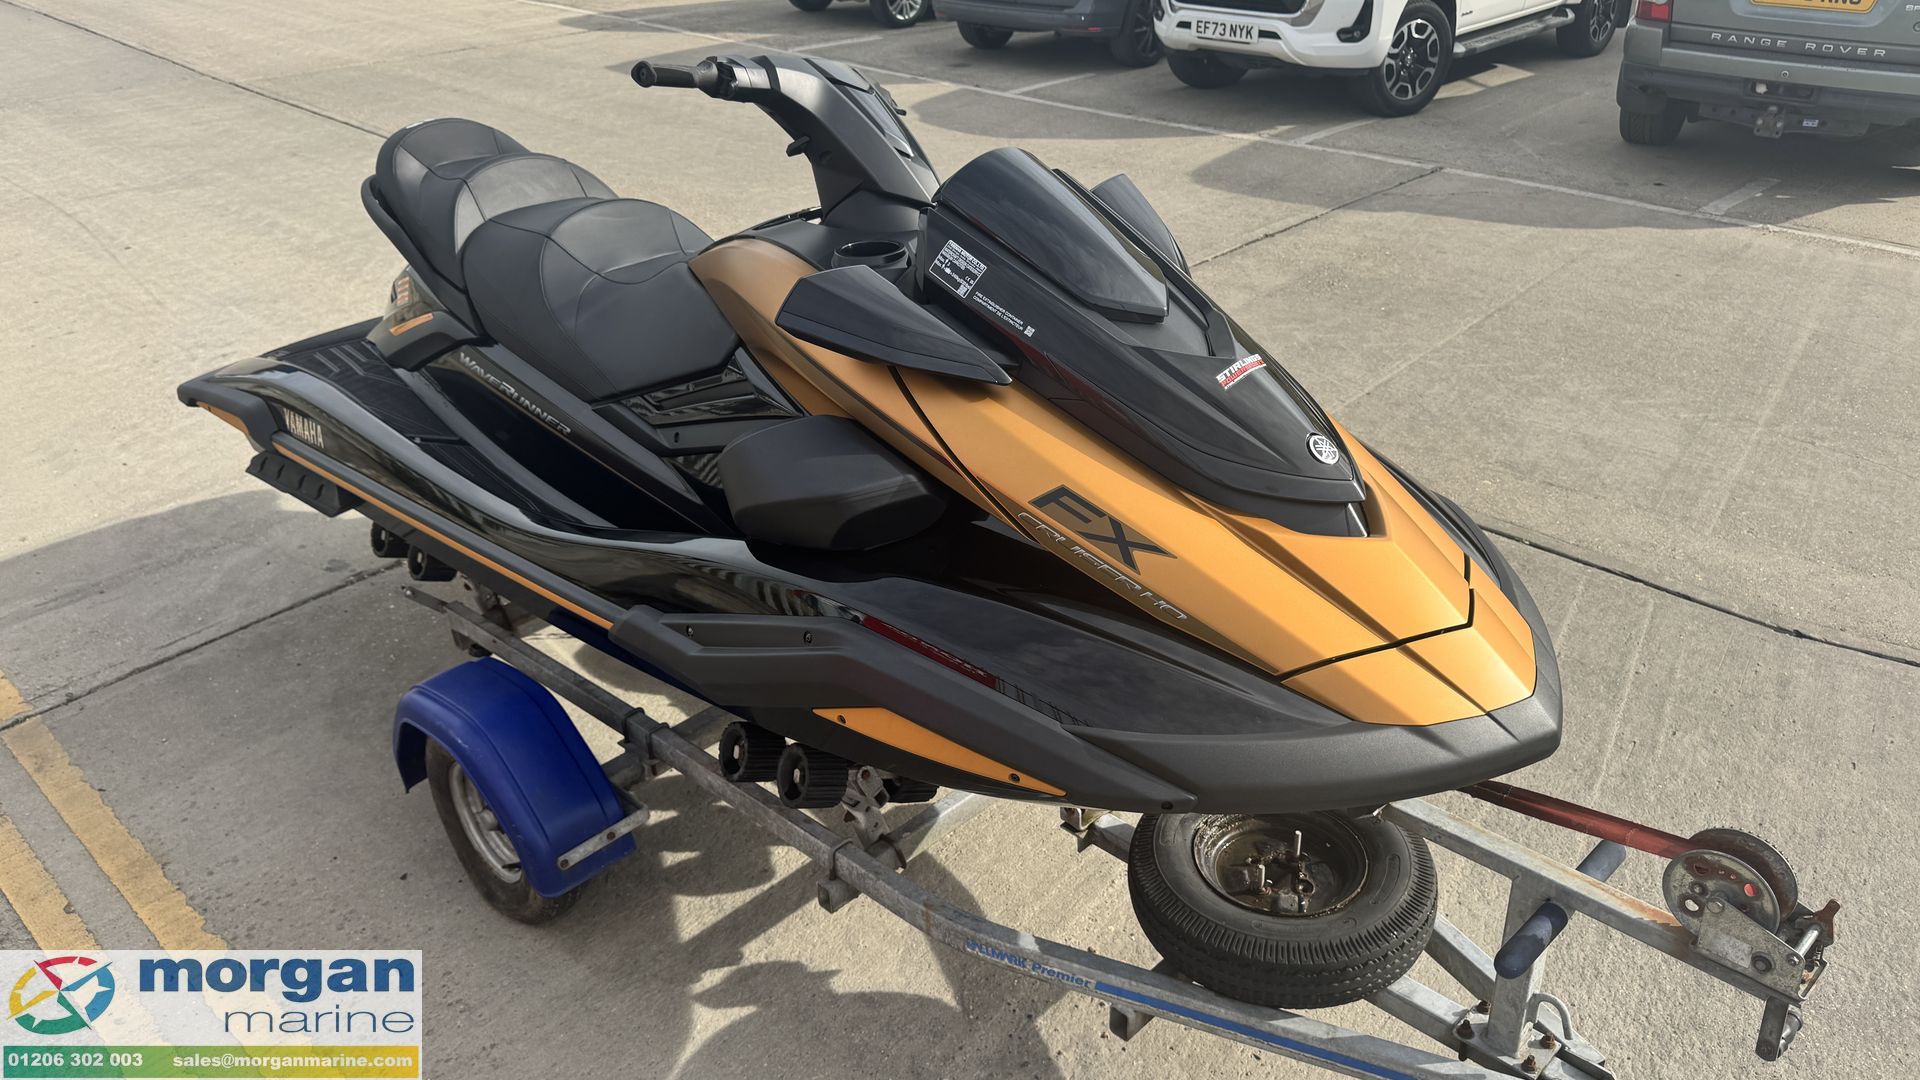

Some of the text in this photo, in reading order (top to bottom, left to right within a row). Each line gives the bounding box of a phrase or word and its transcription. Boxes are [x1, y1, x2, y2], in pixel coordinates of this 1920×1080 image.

[1196, 20, 1254, 40] EF73 NYK
[1711, 32, 1886, 57] RANGE ROVER
[1004, 310, 1024, 325] CONTAINER
[1216, 354, 1262, 383] STIRLINGS
[283, 407, 324, 449] YAMAHA
[1028, 484, 1178, 576] FX
[1031, 960, 1092, 988] Premier
